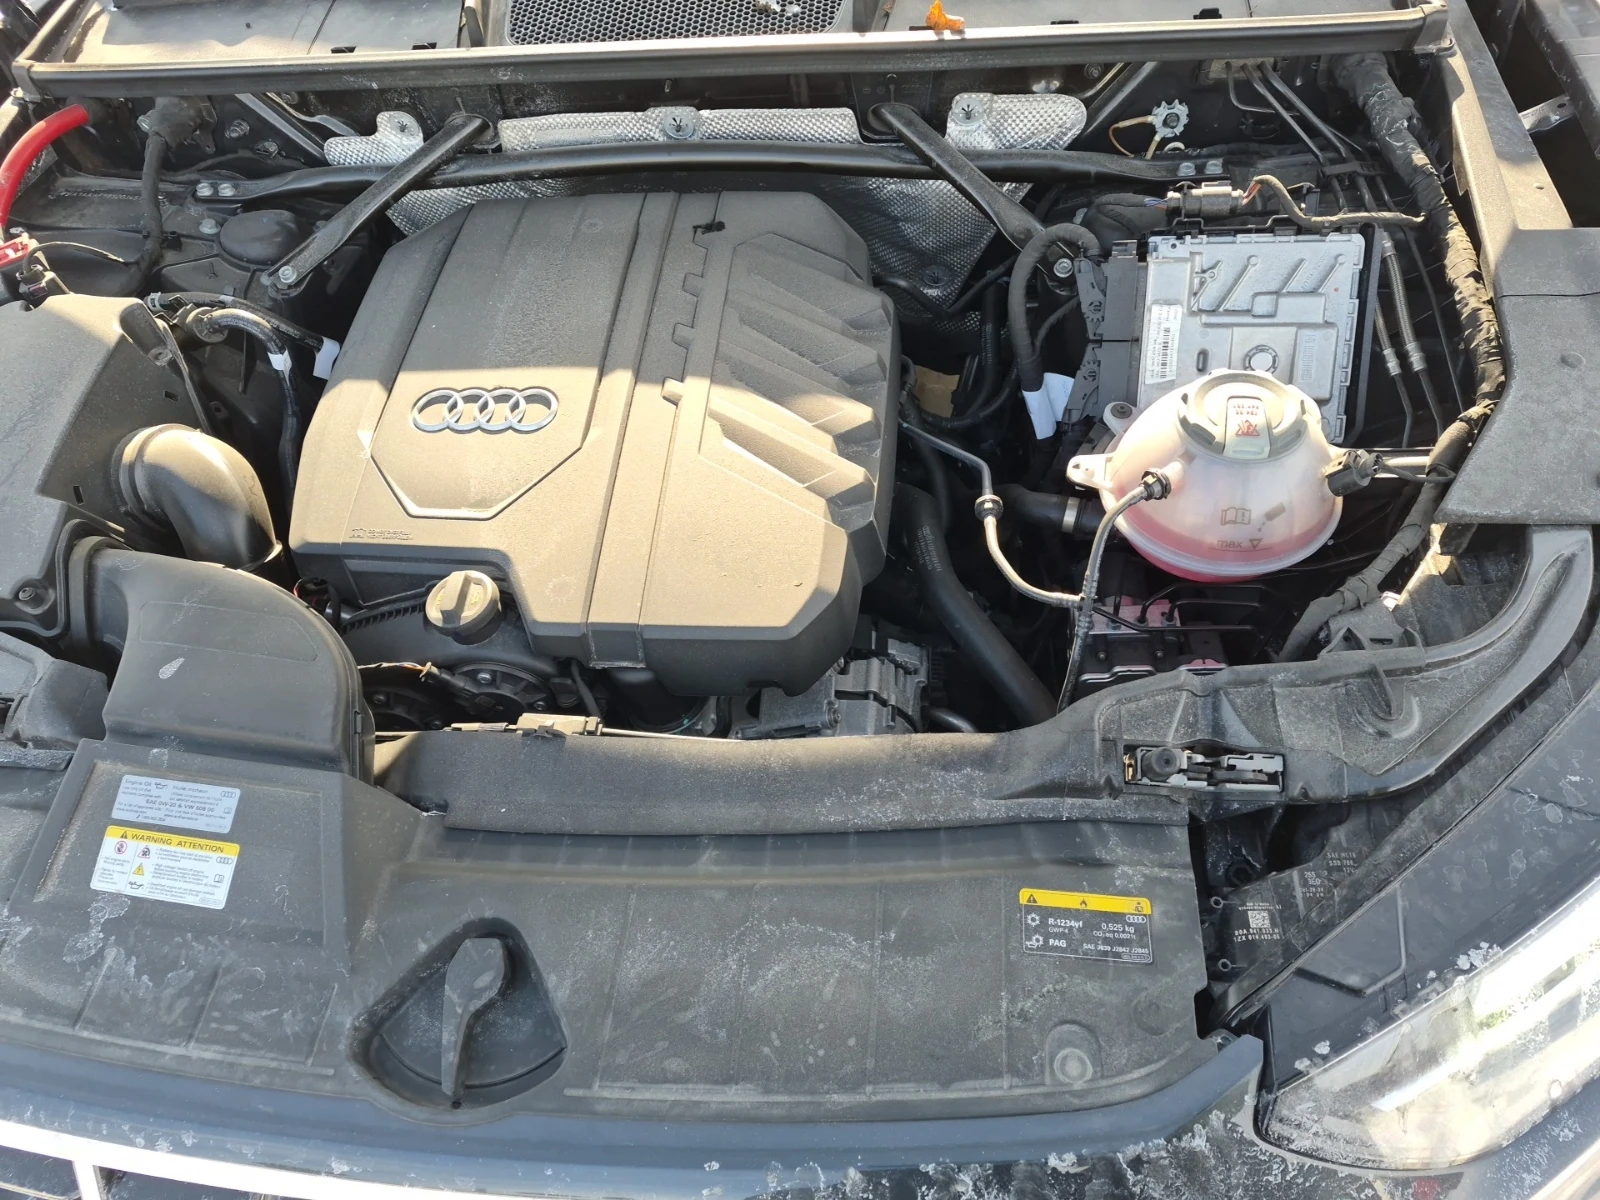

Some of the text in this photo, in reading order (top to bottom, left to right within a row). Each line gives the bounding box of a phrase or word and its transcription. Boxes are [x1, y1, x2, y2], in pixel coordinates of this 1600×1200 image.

[1216, 539, 1243, 549] max
[131, 833, 225, 853] WARNING ATTENTION
[1048, 918, 1083, 928] R-1234yf
[1125, 924, 1135, 933] kg
[1049, 939, 1067, 948] PAG
